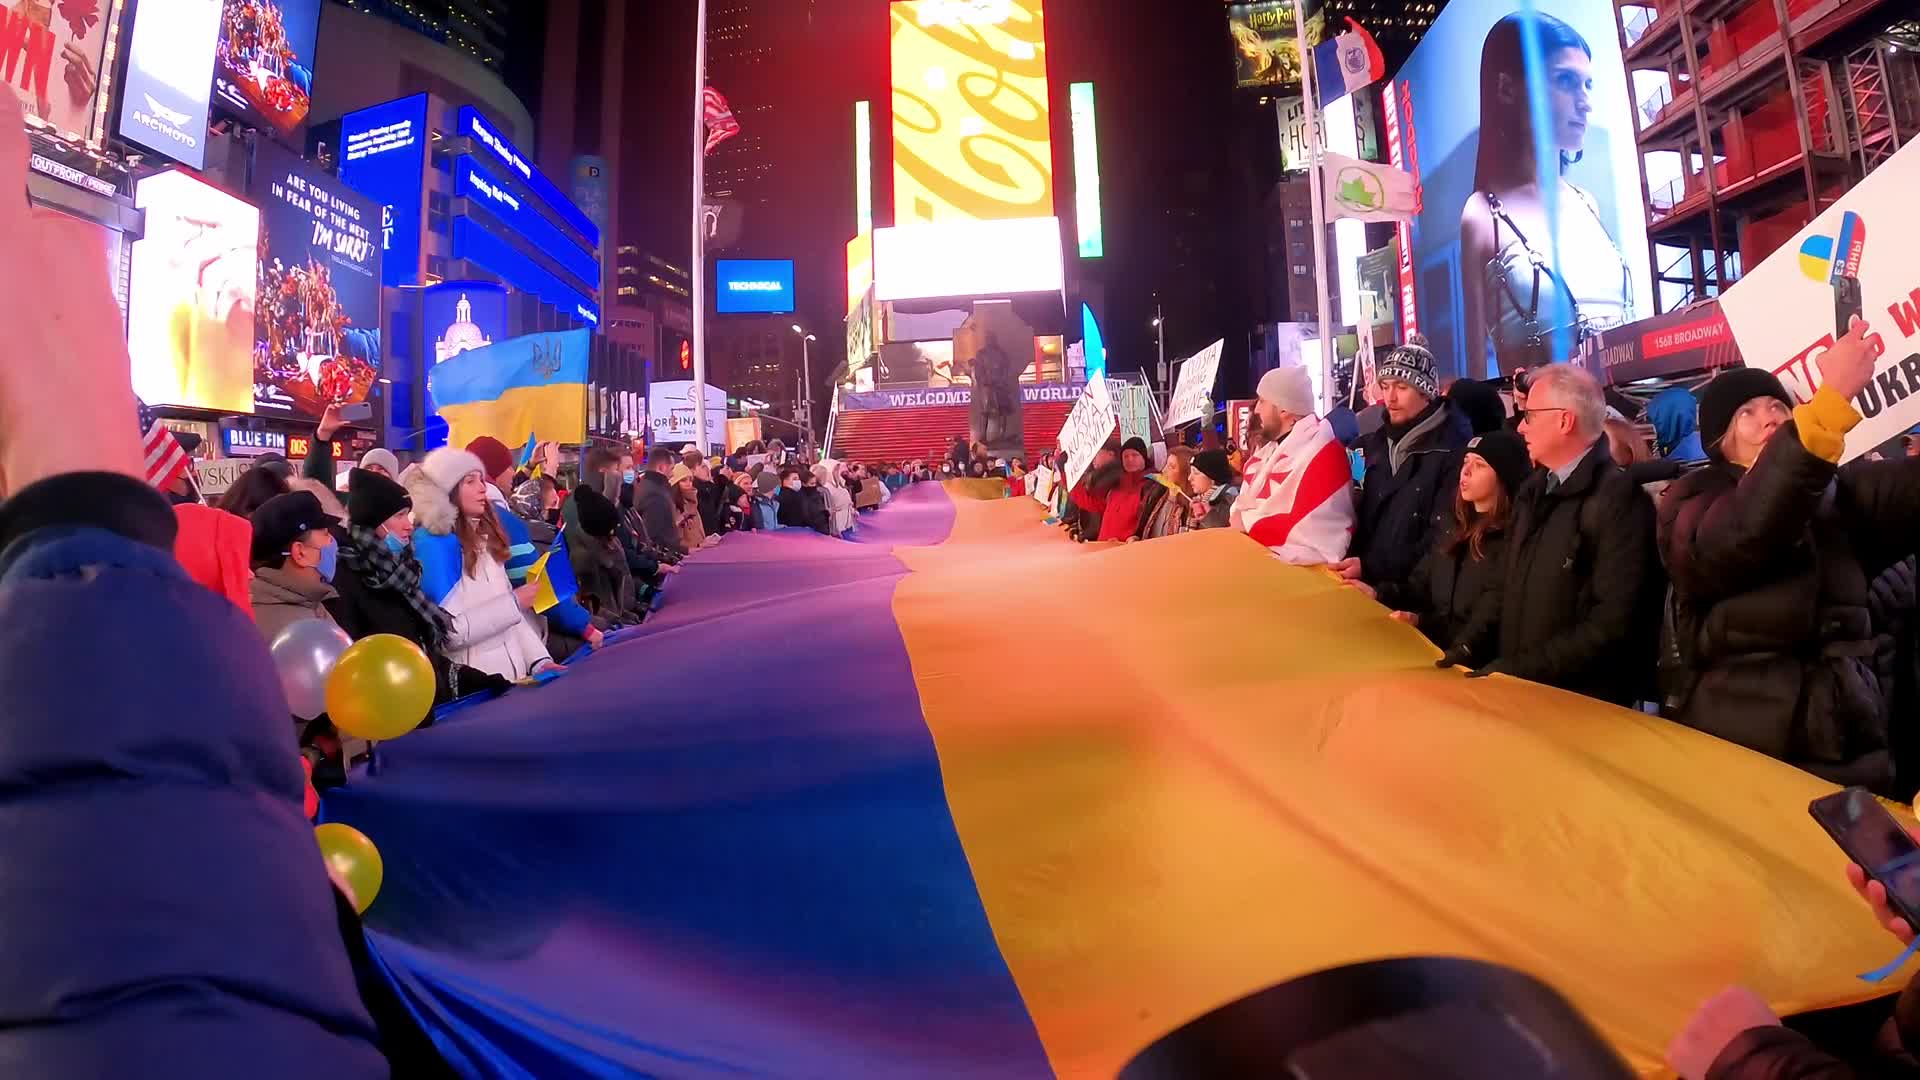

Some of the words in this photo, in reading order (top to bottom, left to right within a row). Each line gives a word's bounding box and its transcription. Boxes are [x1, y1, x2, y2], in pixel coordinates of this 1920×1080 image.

[1249, 12, 1276, 29] Harry
[1275, 7, 1297, 24] Pott
[132, 110, 196, 148] ARCIMOTO
[33, 158, 85, 184] OUTFRONT
[286, 173, 306, 192] ARE
[309, 184, 329, 203] YOU
[330, 196, 360, 220] LIVING
[271, 182, 283, 198] IN
[286, 190, 311, 213] FEAR
[314, 205, 328, 219] OF
[330, 212, 346, 230] THE
[349, 222, 370, 242] NEXT
[1834, 259, 1845, 276] ЕЗ
[1655, 334, 1673, 349] 1568
[1674, 322, 1725, 345] BROADWAY
[1379, 367, 1412, 379] ORTH
[890, 391, 971, 407] WELCOME
[1024, 386, 1082, 402] WORLD
[1072, 383, 1094, 429] BAN
[653, 416, 698, 429] ORIGINA
[1068, 403, 1101, 461] RUSSIA
[230, 429, 262, 447] BLUE
[265, 431, 285, 448] FIN
[290, 438, 307, 455] DOS
[195, 465, 235, 487] VSKI
